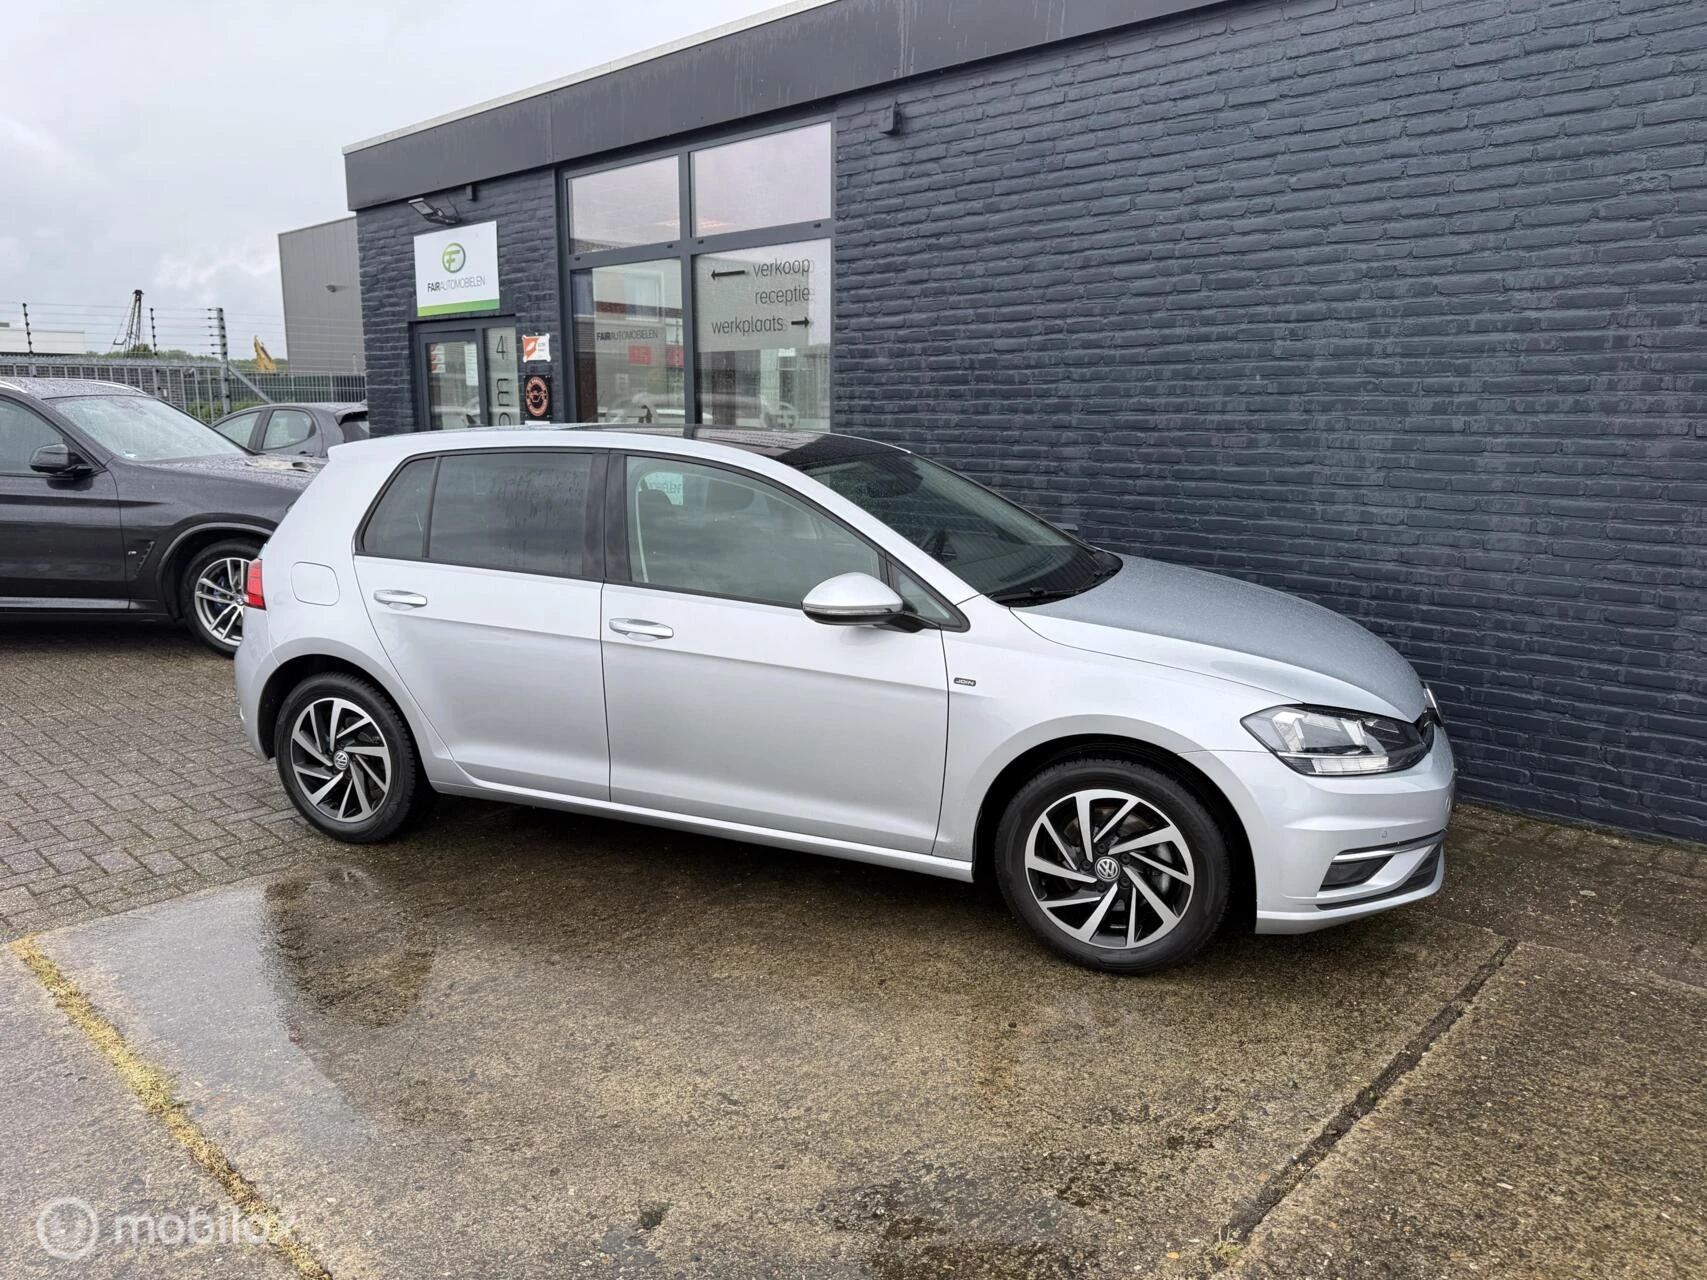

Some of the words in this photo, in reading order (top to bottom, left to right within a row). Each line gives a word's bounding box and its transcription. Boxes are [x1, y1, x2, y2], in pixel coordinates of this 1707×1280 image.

[753, 258, 810, 277] verkoop
[755, 285, 810, 306] receptie
[711, 316, 784, 336] werkplaats
[496, 335, 506, 360] 4
